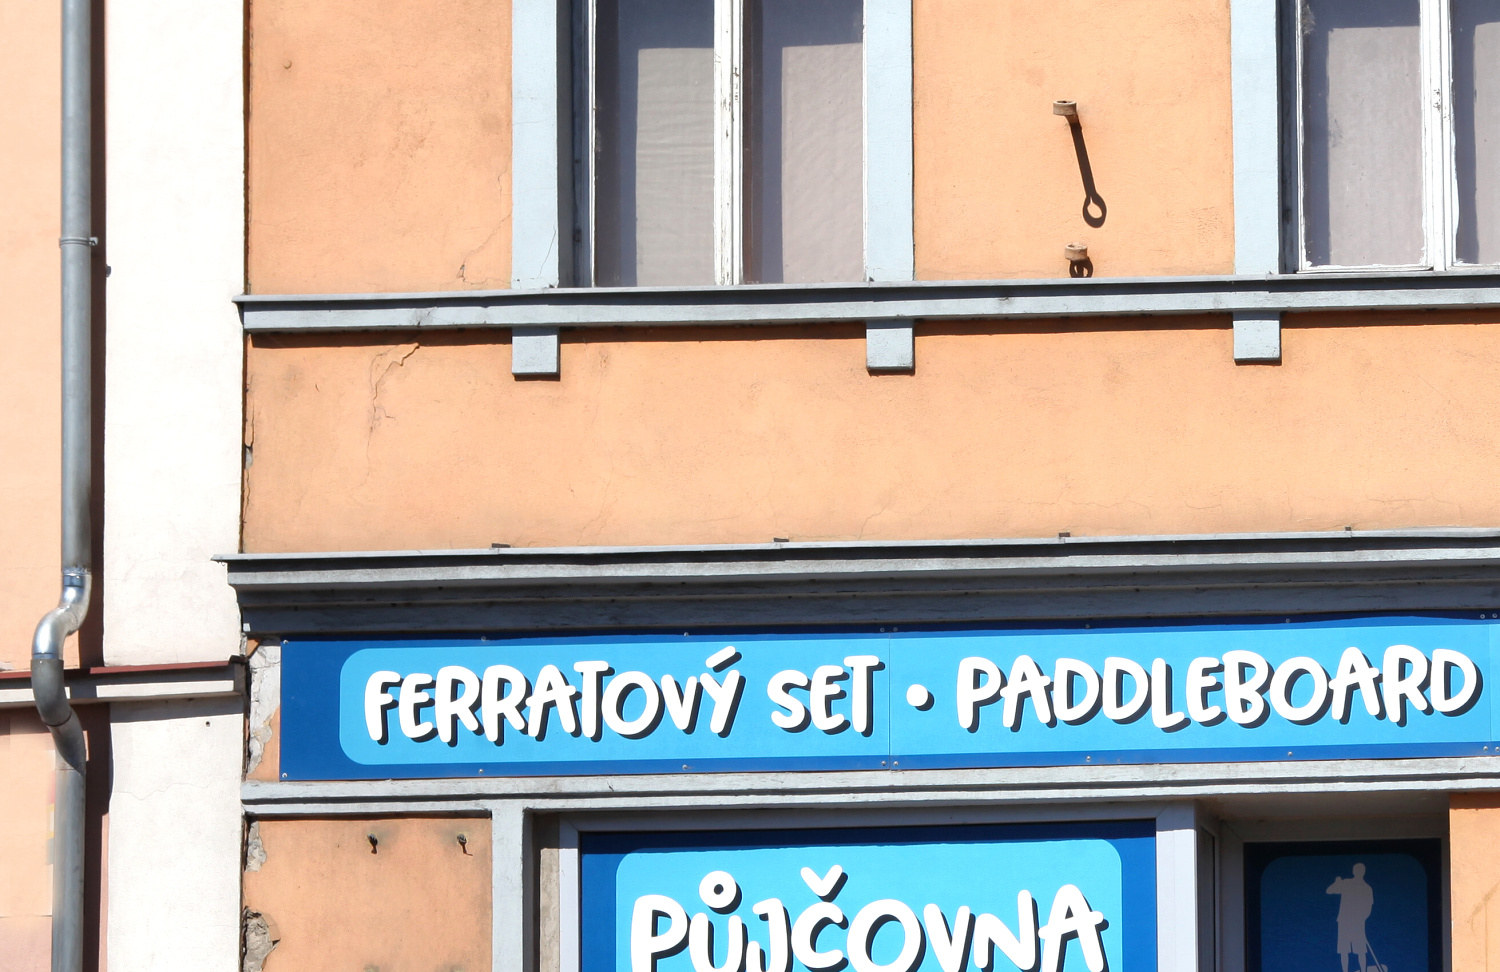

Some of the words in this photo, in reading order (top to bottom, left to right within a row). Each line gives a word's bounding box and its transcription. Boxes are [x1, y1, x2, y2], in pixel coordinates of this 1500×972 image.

[364, 645, 742, 744] FERRATOVÝ
[766, 654, 882, 734] SET
[956, 644, 1479, 730] PADDLEBOARD
